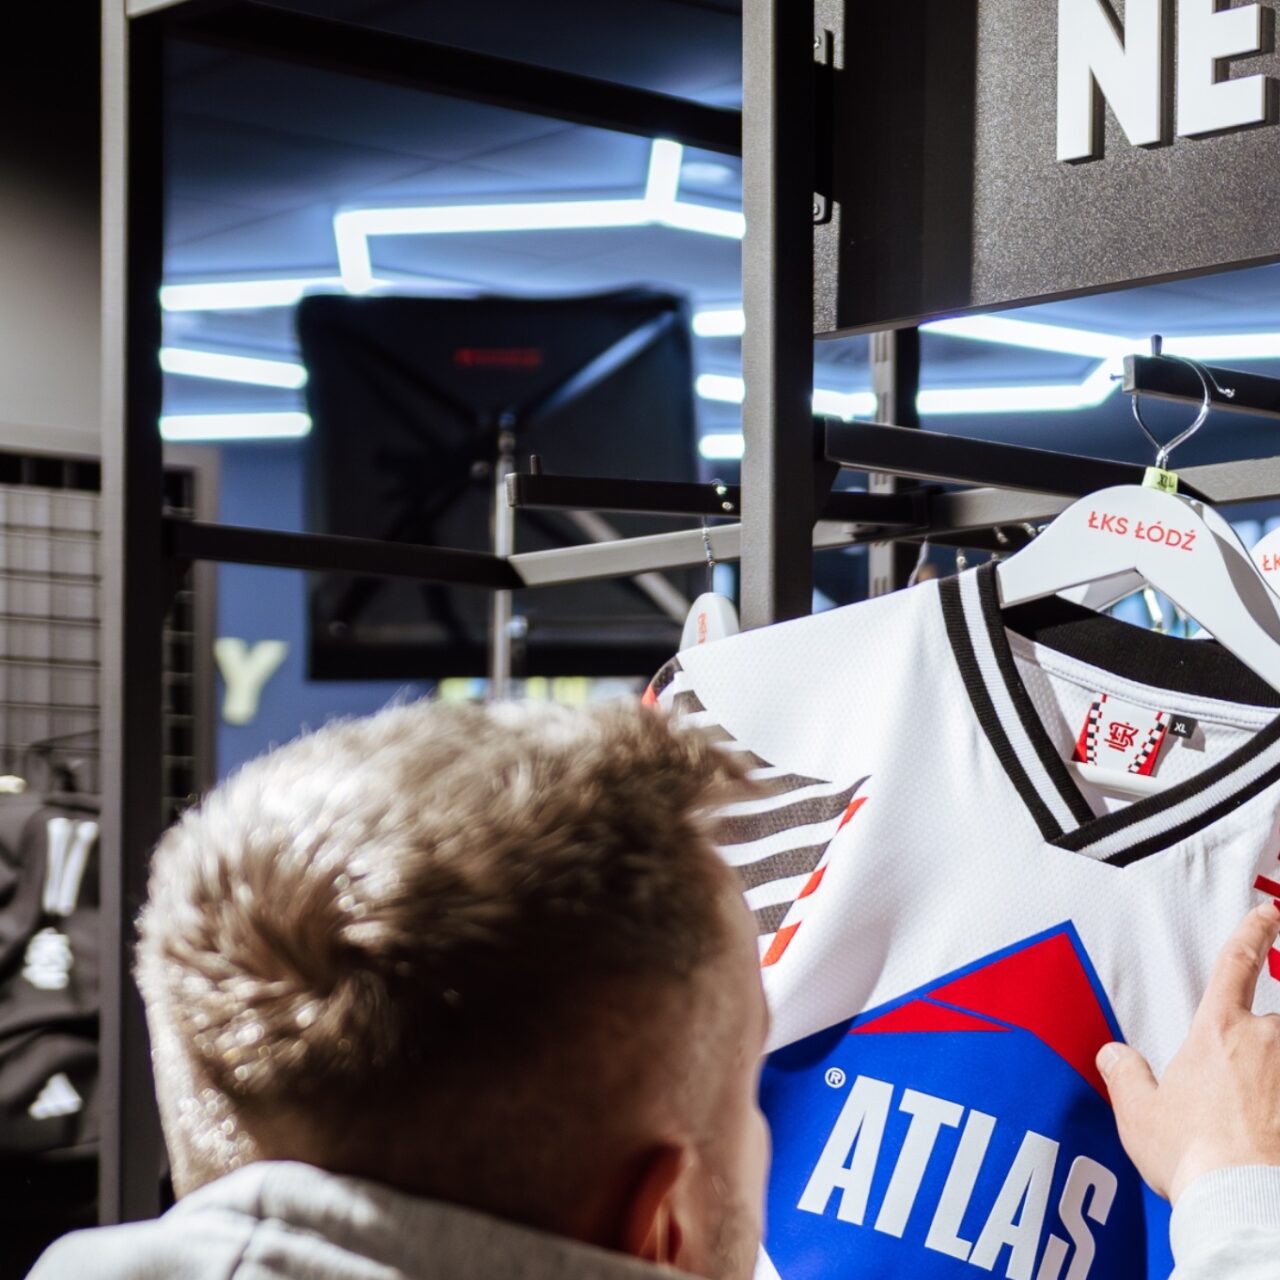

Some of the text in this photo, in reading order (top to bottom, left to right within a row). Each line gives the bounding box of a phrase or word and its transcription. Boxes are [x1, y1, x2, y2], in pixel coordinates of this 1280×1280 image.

[1087, 511, 1197, 552] ŁKS ŁÓDŹ
[1173, 722, 1187, 734] XL
